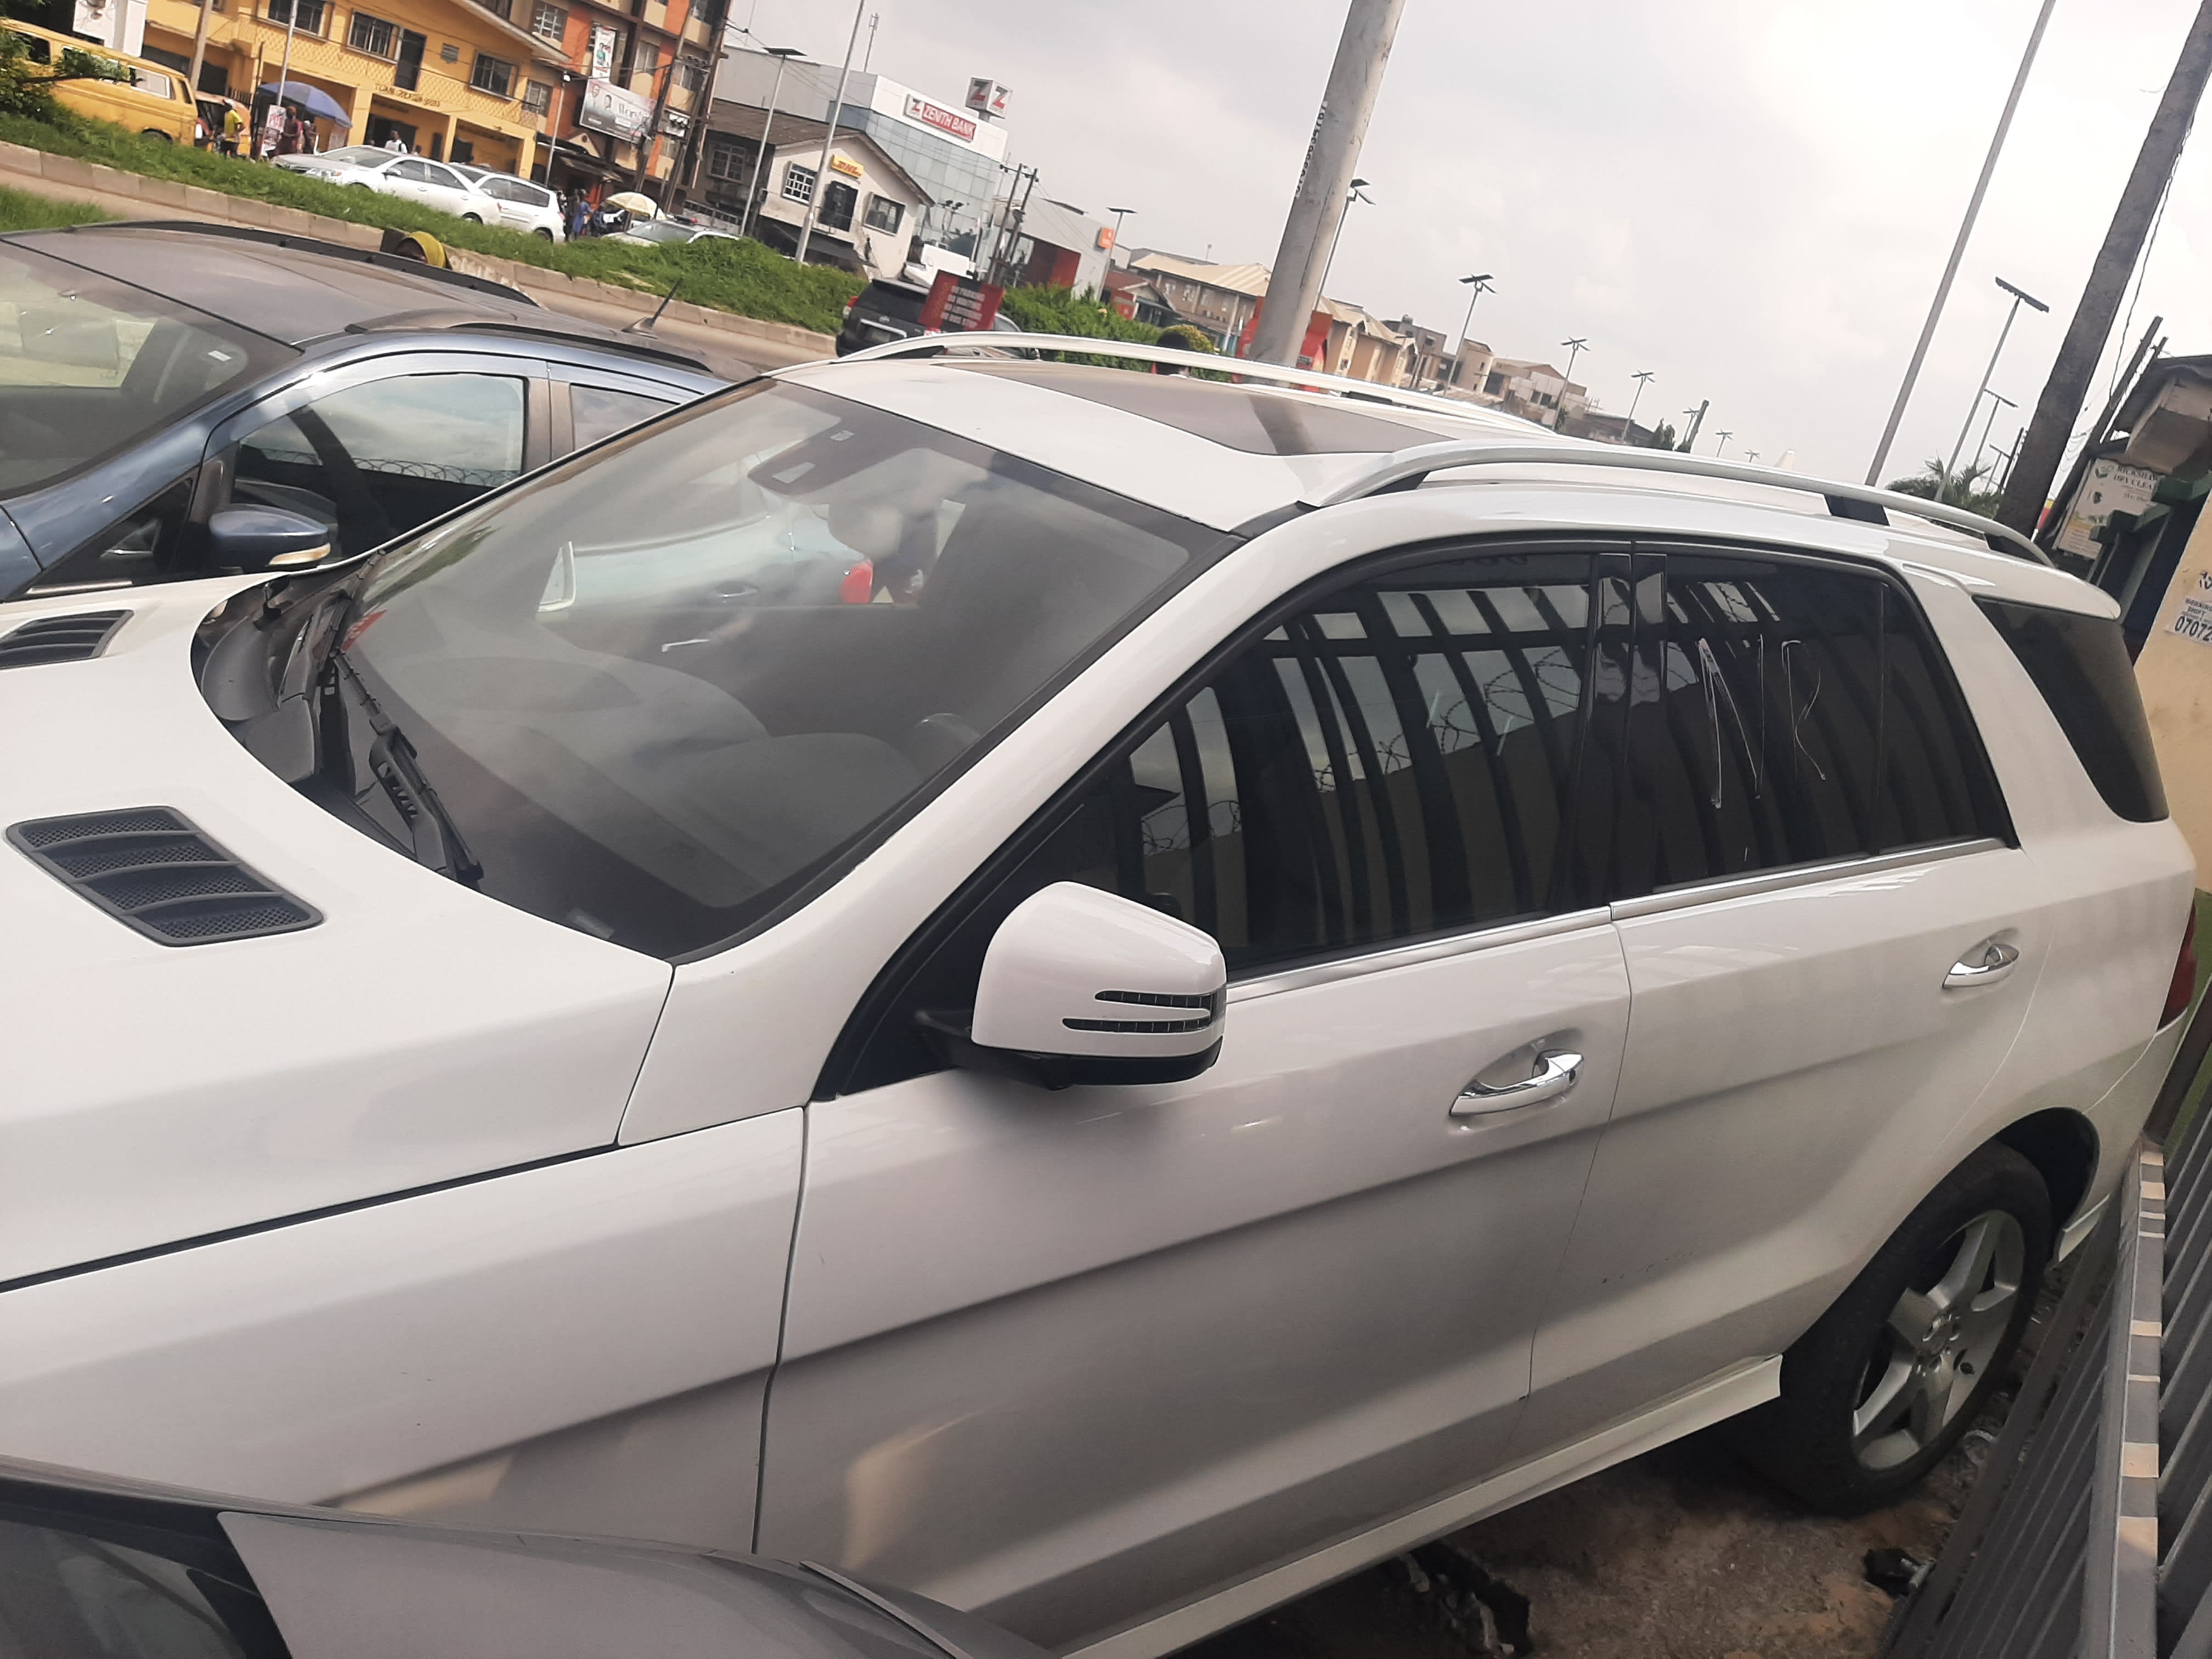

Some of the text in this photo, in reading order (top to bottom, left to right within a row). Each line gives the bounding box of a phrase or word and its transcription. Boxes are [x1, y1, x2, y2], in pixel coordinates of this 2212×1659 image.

[970, 80, 989, 101] Z
[992, 86, 1008, 109] Z
[922, 105, 953, 128] ZENITH
[951, 117, 975, 137] BANK
[2131, 479, 2153, 490] CLEA
[2175, 616, 2212, 641] 07072
